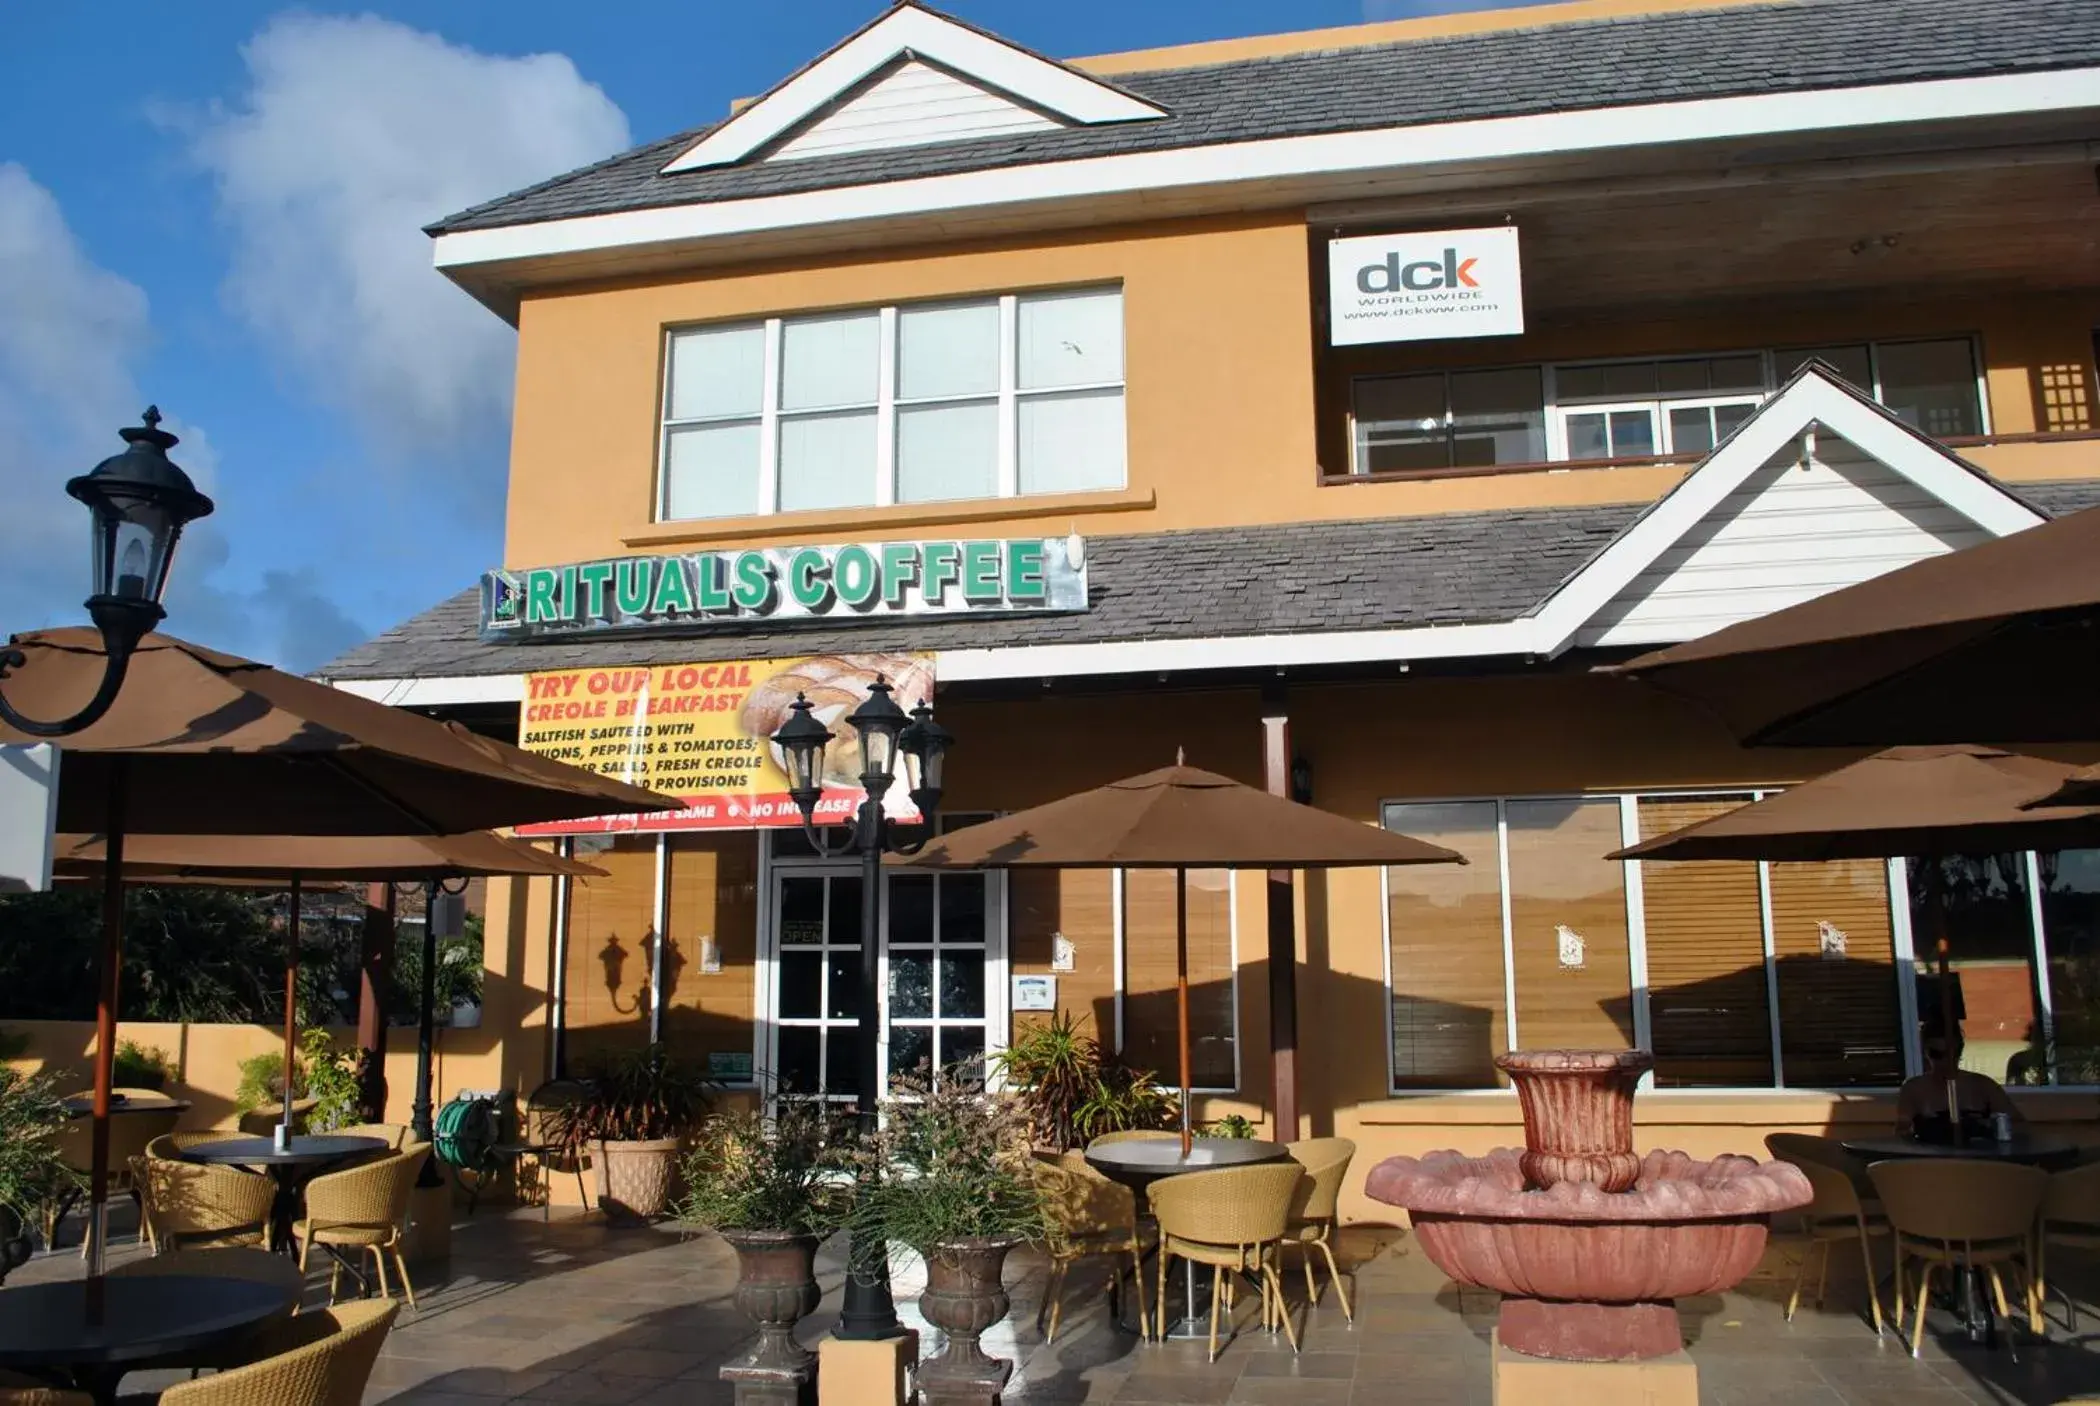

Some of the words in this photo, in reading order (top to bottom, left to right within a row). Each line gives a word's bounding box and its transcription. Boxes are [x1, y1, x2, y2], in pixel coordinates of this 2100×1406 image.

[1356, 248, 1479, 294] dck
[1358, 291, 1484, 306] WORLDWIDE
[1344, 304, 1499, 320] www.dckww.com
[526, 551, 771, 624] RITUALS
[788, 540, 1046, 607] COFFEE
[527, 674, 580, 699] TRY
[660, 665, 752, 691] LOCAL
[527, 700, 607, 721] CREOLE
[524, 729, 585, 743] SALTFISH
[657, 723, 694, 736] WITH
[658, 742, 668, 754] &
[674, 738, 758, 753] TOMATOES;
[655, 759, 700, 771] FRESH
[705, 756, 763, 769] CREOLE
[655, 775, 748, 789] PROVISIONS
[750, 803, 773, 817] NO
